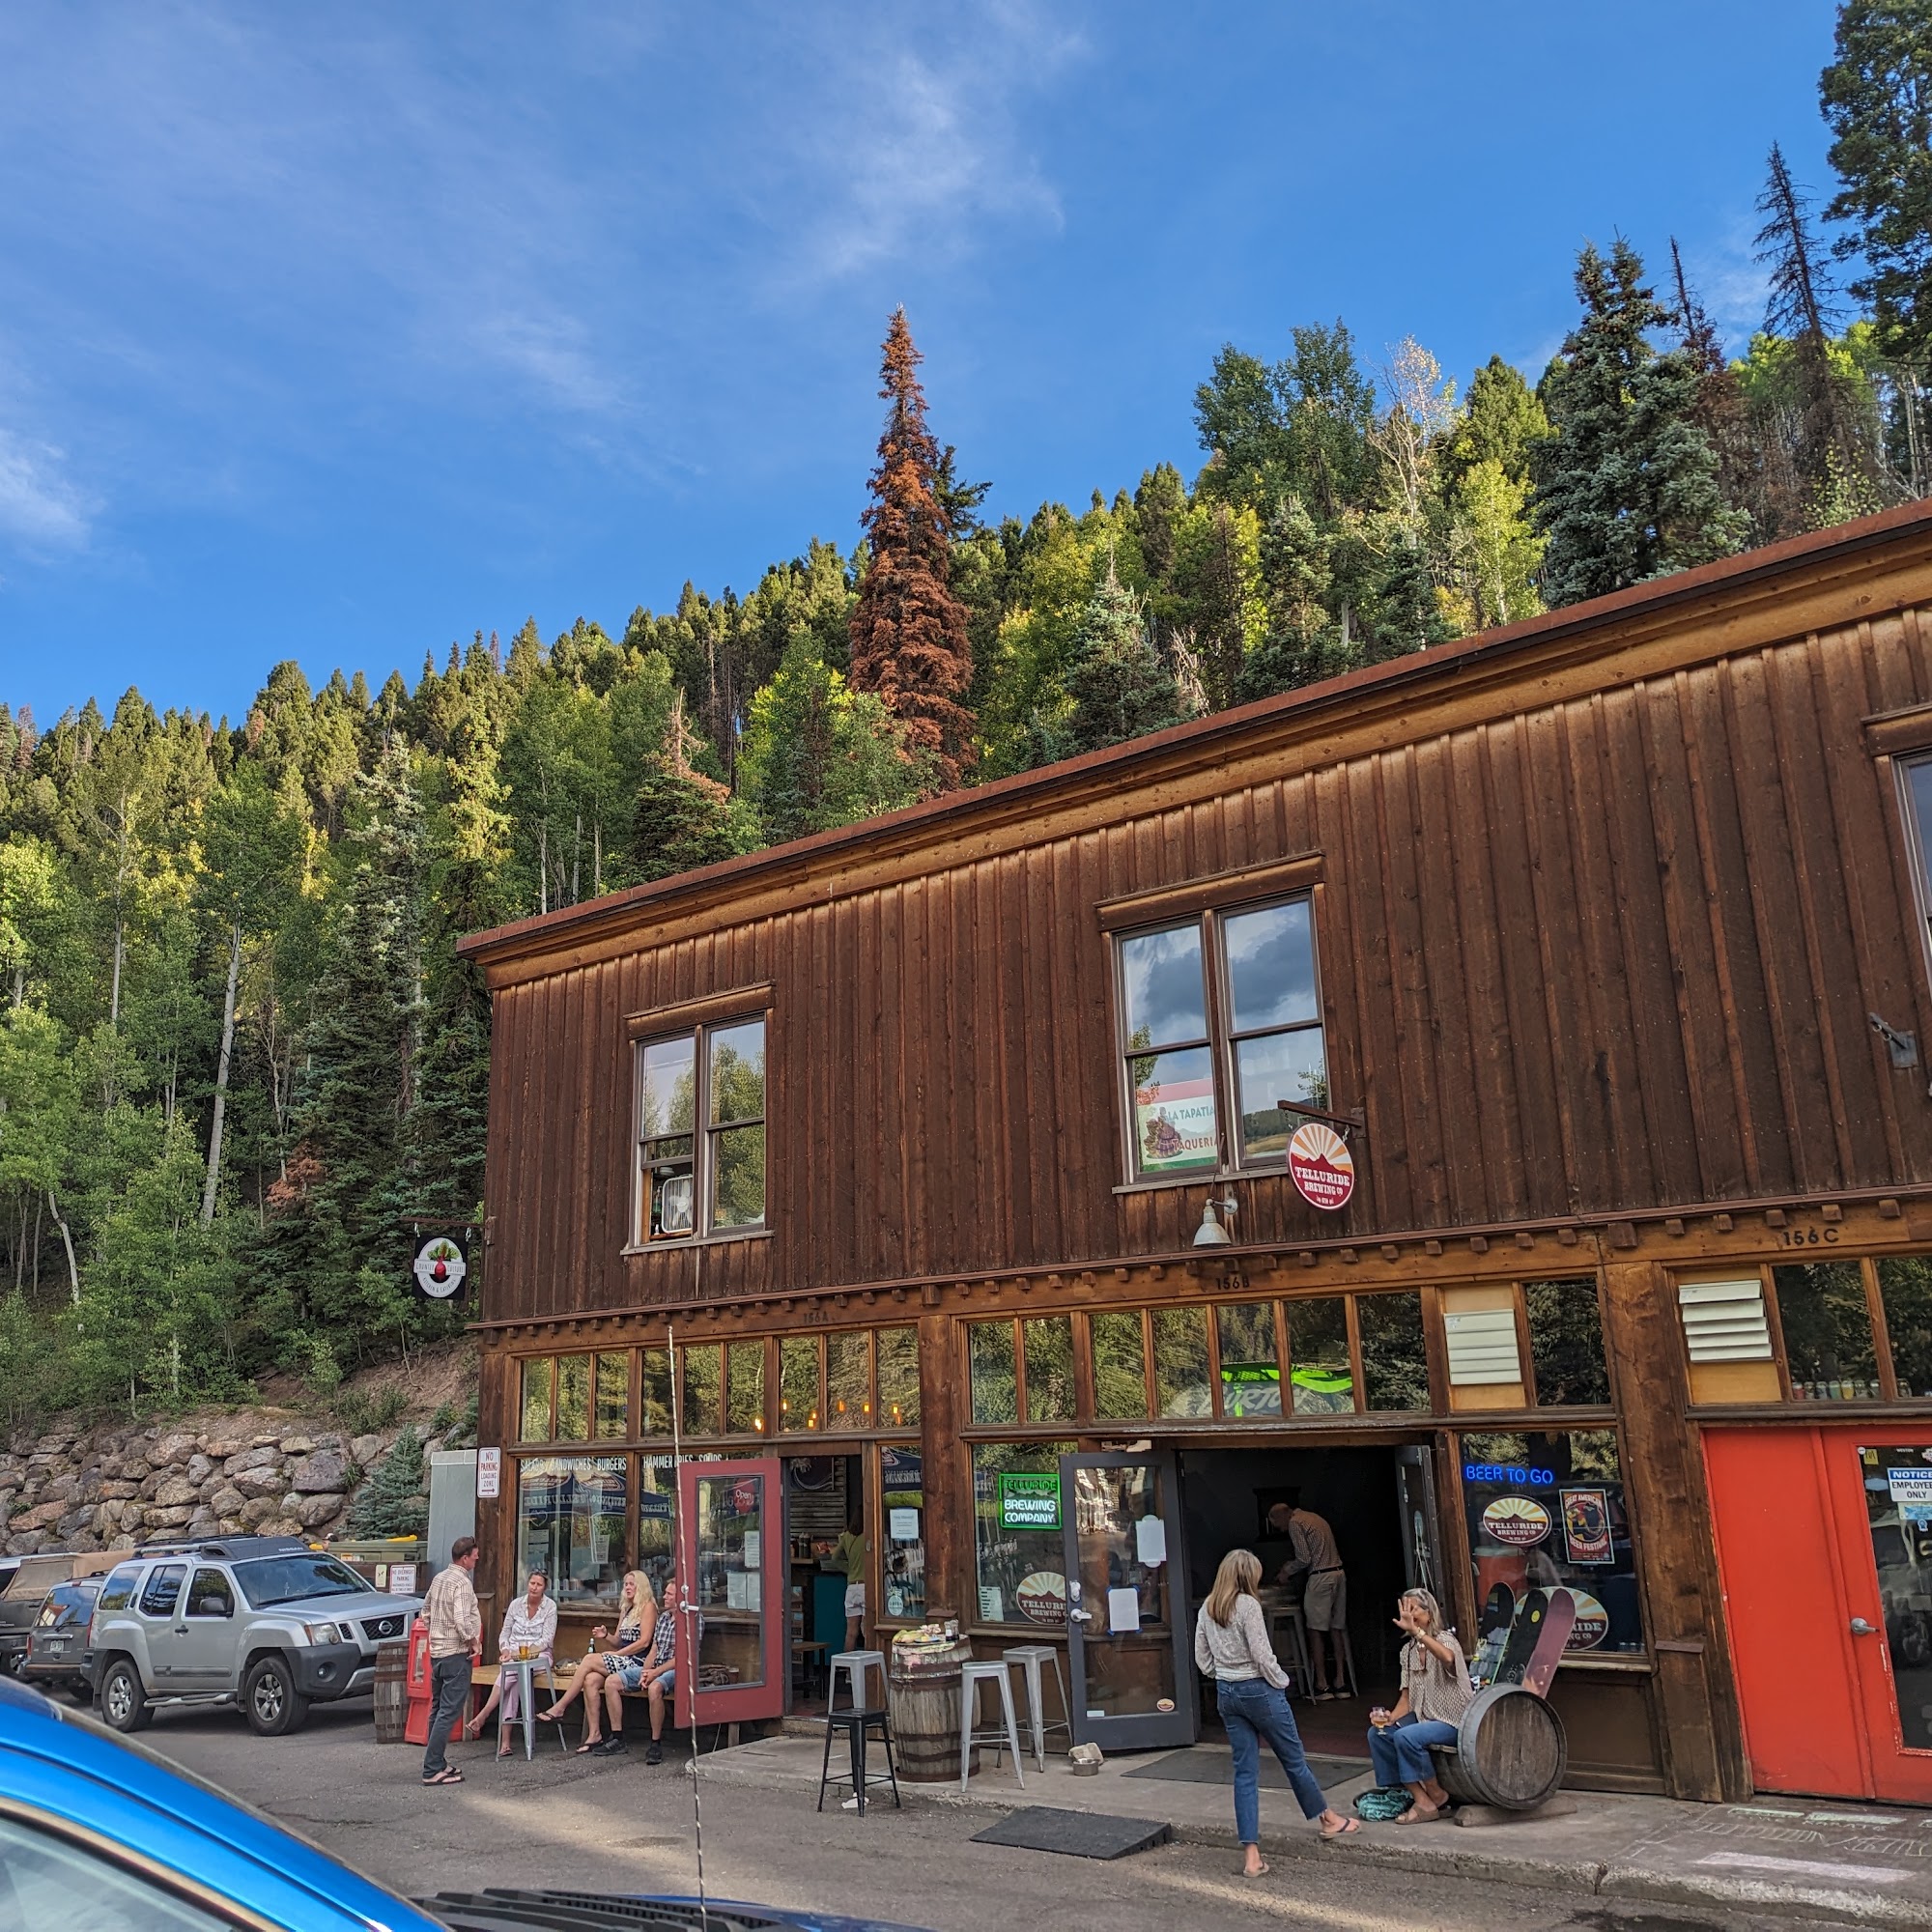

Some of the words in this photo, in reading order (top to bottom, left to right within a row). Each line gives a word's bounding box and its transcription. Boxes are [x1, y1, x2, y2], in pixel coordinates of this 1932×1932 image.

[1294, 1166, 1350, 1187] TELLURIDE
[1304, 1180, 1336, 1195] BREWING
[1783, 1226, 1839, 1246] 156C
[1215, 1275, 1250, 1291] 156B
[485, 1451, 494, 1462] NO
[643, 1455, 673, 1468] HAMMER
[480, 1462, 497, 1471] PARKING
[551, 1457, 591, 1471] SANDWICHES
[597, 1457, 627, 1471] BURGERS
[1466, 1465, 1503, 1481] BEER
[1506, 1468, 1526, 1483] TO
[1530, 1468, 1553, 1484] GO
[1005, 1479, 1057, 1491] TELLURIDE
[735, 1490, 752, 1500] Open
[1906, 1491, 1927, 1499] ONLY
[1005, 1498, 1056, 1512] BREWING
[1005, 1512, 1056, 1523] COMPANY
[1488, 1521, 1544, 1530] TELLURIDE
[1021, 1600, 1066, 1610] TELLURI
[1030, 1608, 1062, 1617] BREWING
